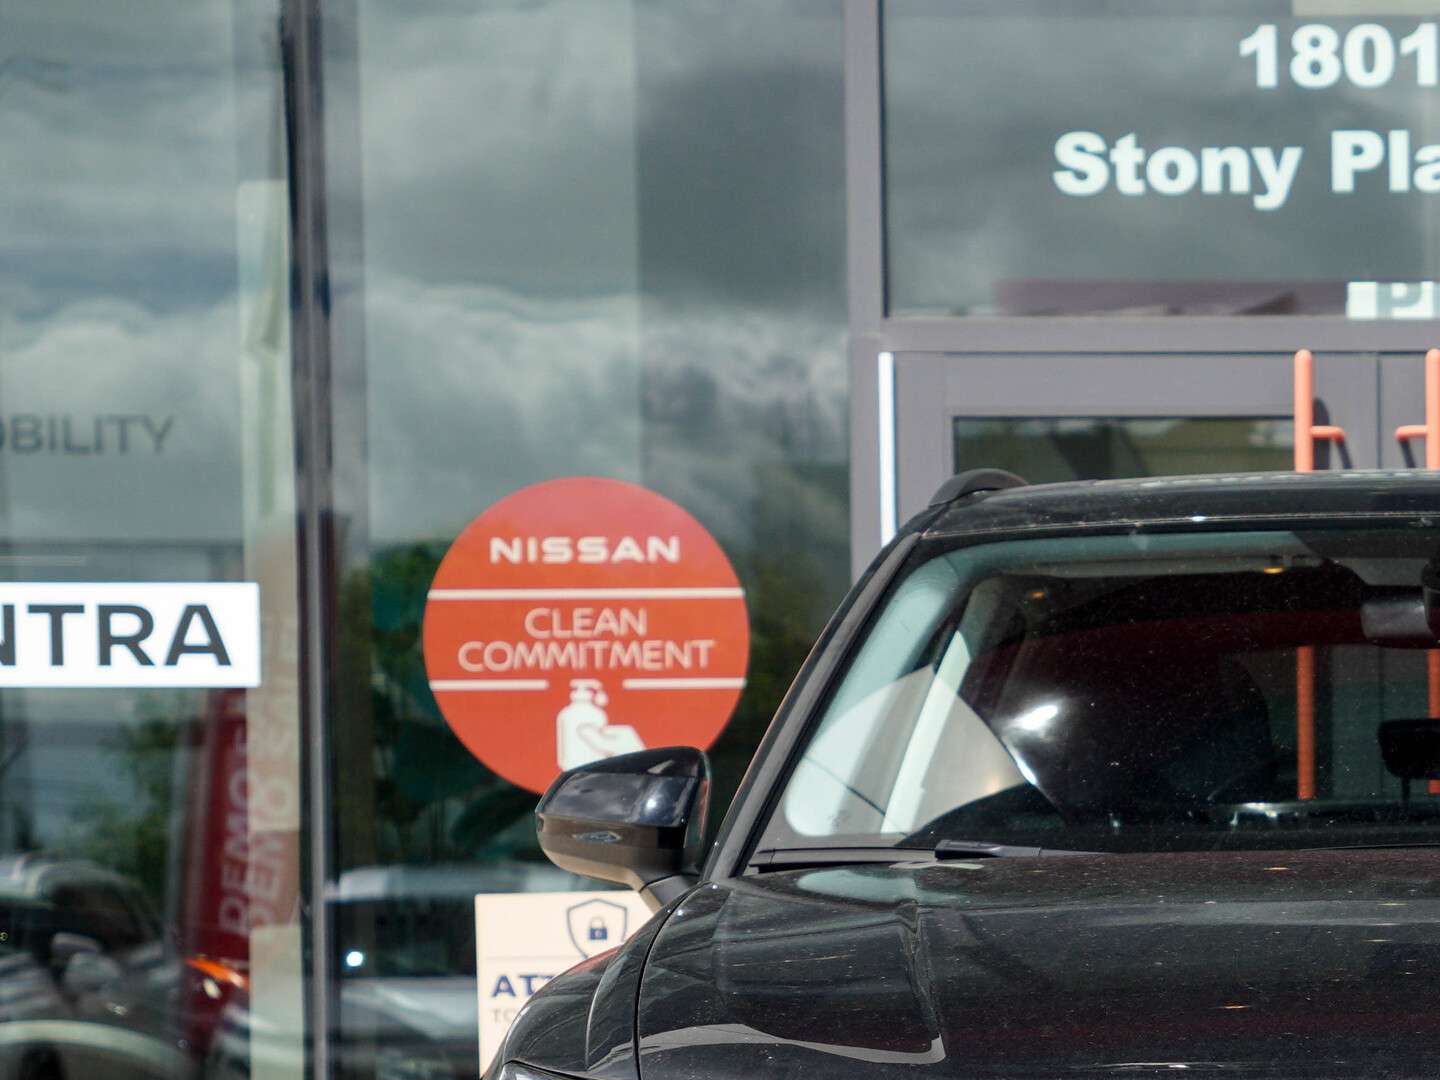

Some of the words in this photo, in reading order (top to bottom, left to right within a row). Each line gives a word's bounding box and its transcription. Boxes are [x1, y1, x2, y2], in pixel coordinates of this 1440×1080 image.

[1052, 131, 1303, 211] Stony
[0, 413, 174, 455] BILITY
[489, 536, 681, 564] NISSAN
[524, 607, 647, 637] CLEAN
[458, 639, 716, 672] COMMITMENT
